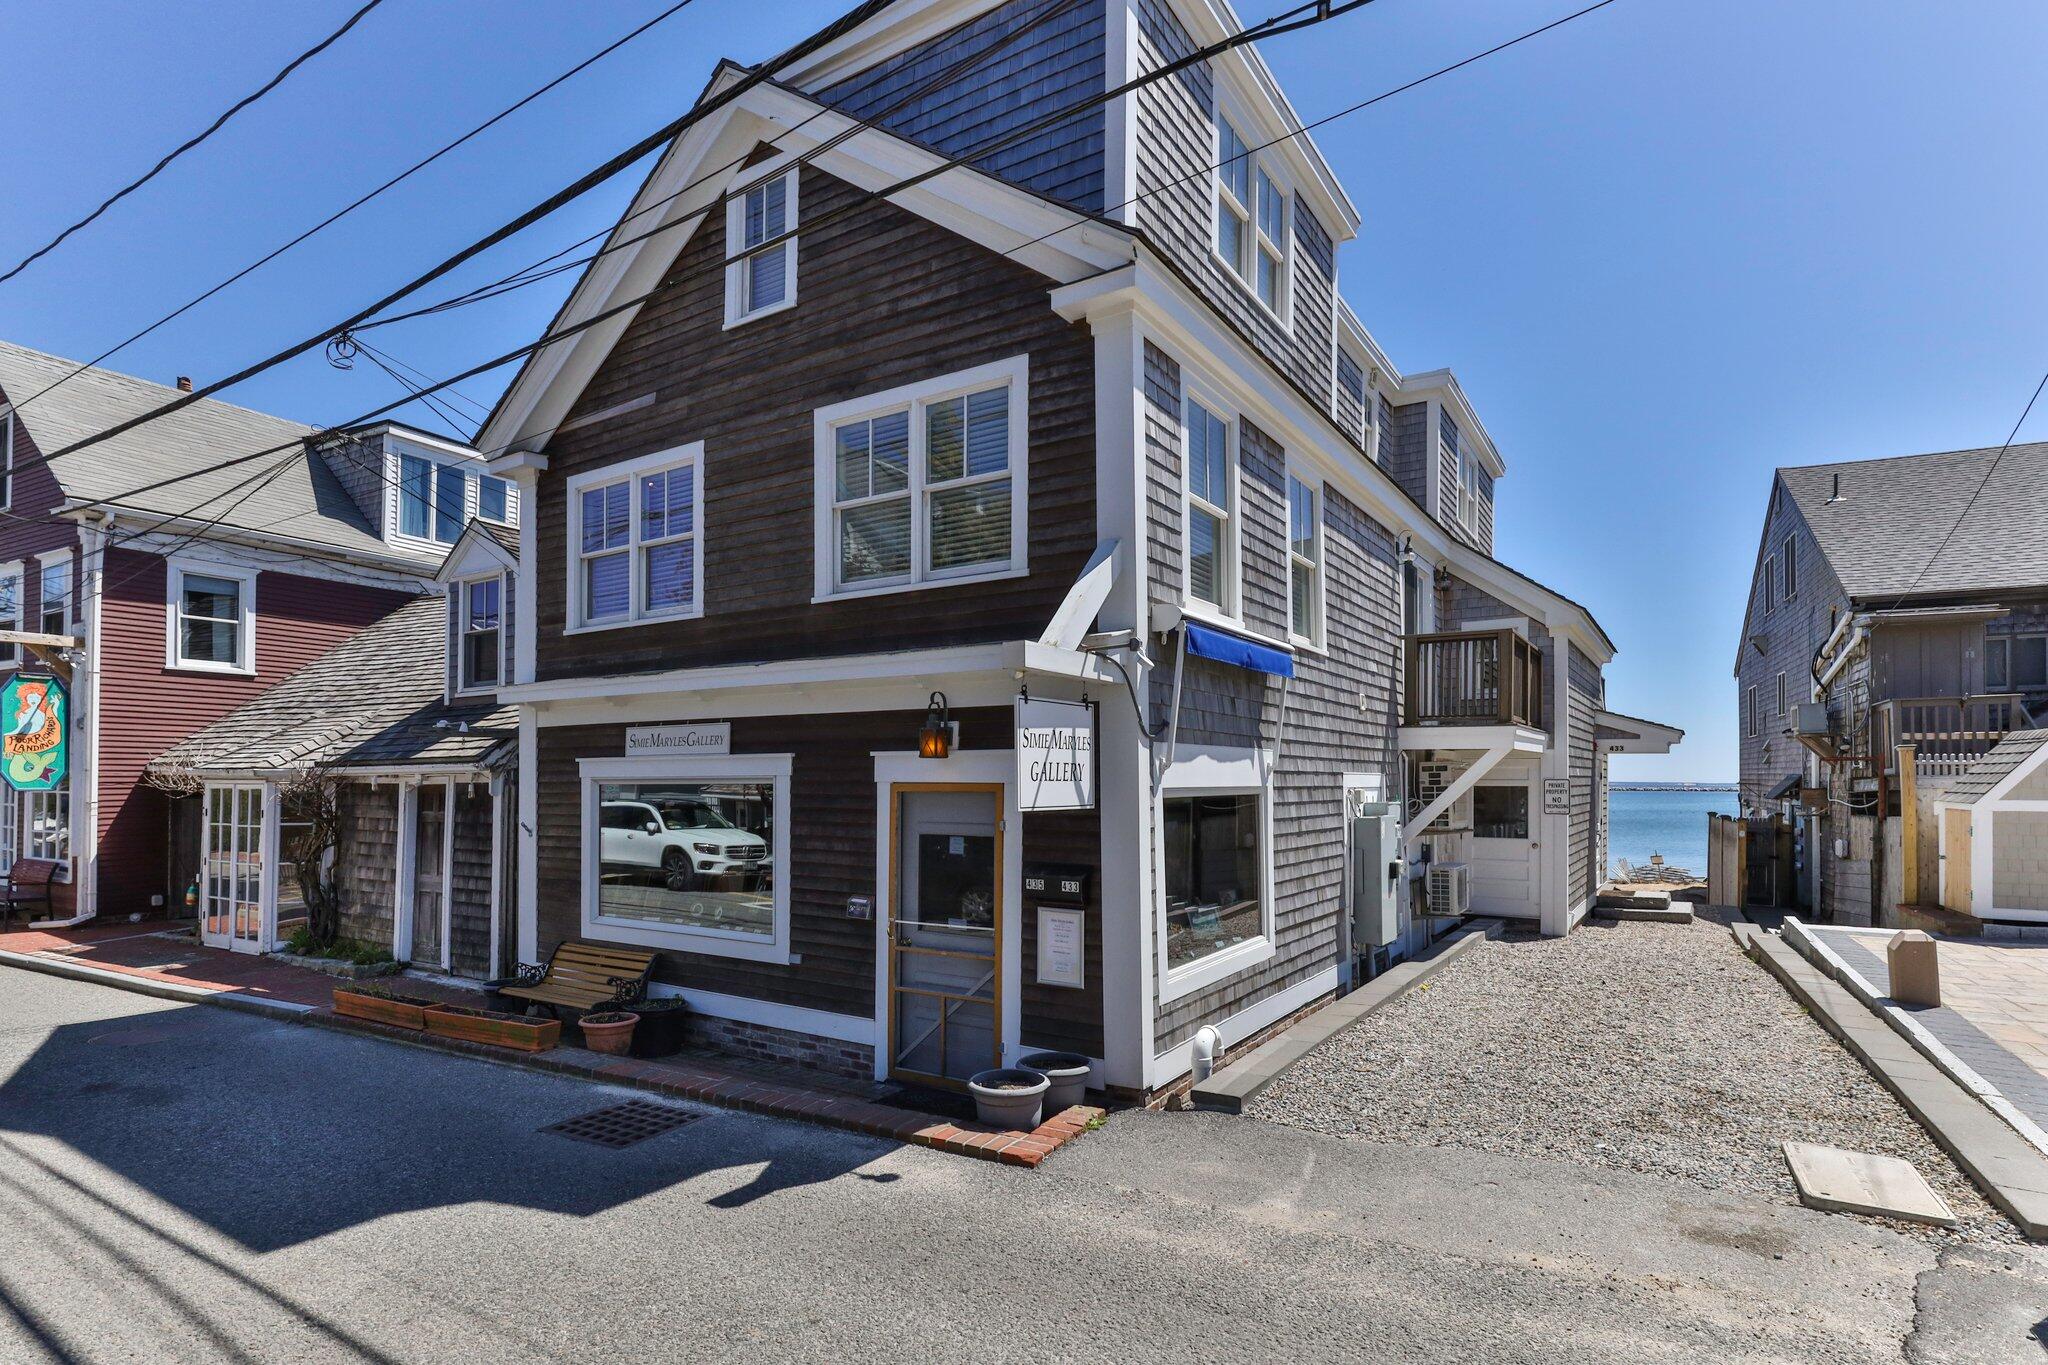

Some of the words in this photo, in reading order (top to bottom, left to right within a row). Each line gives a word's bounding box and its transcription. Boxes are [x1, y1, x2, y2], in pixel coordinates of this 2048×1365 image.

[13, 739, 55, 754] LANDING
[1022, 727, 1050, 748] SIMIE
[1051, 729, 1091, 751] MARYLES
[1030, 761, 1085, 782] GALLERY
[1061, 880, 1080, 892] 433
